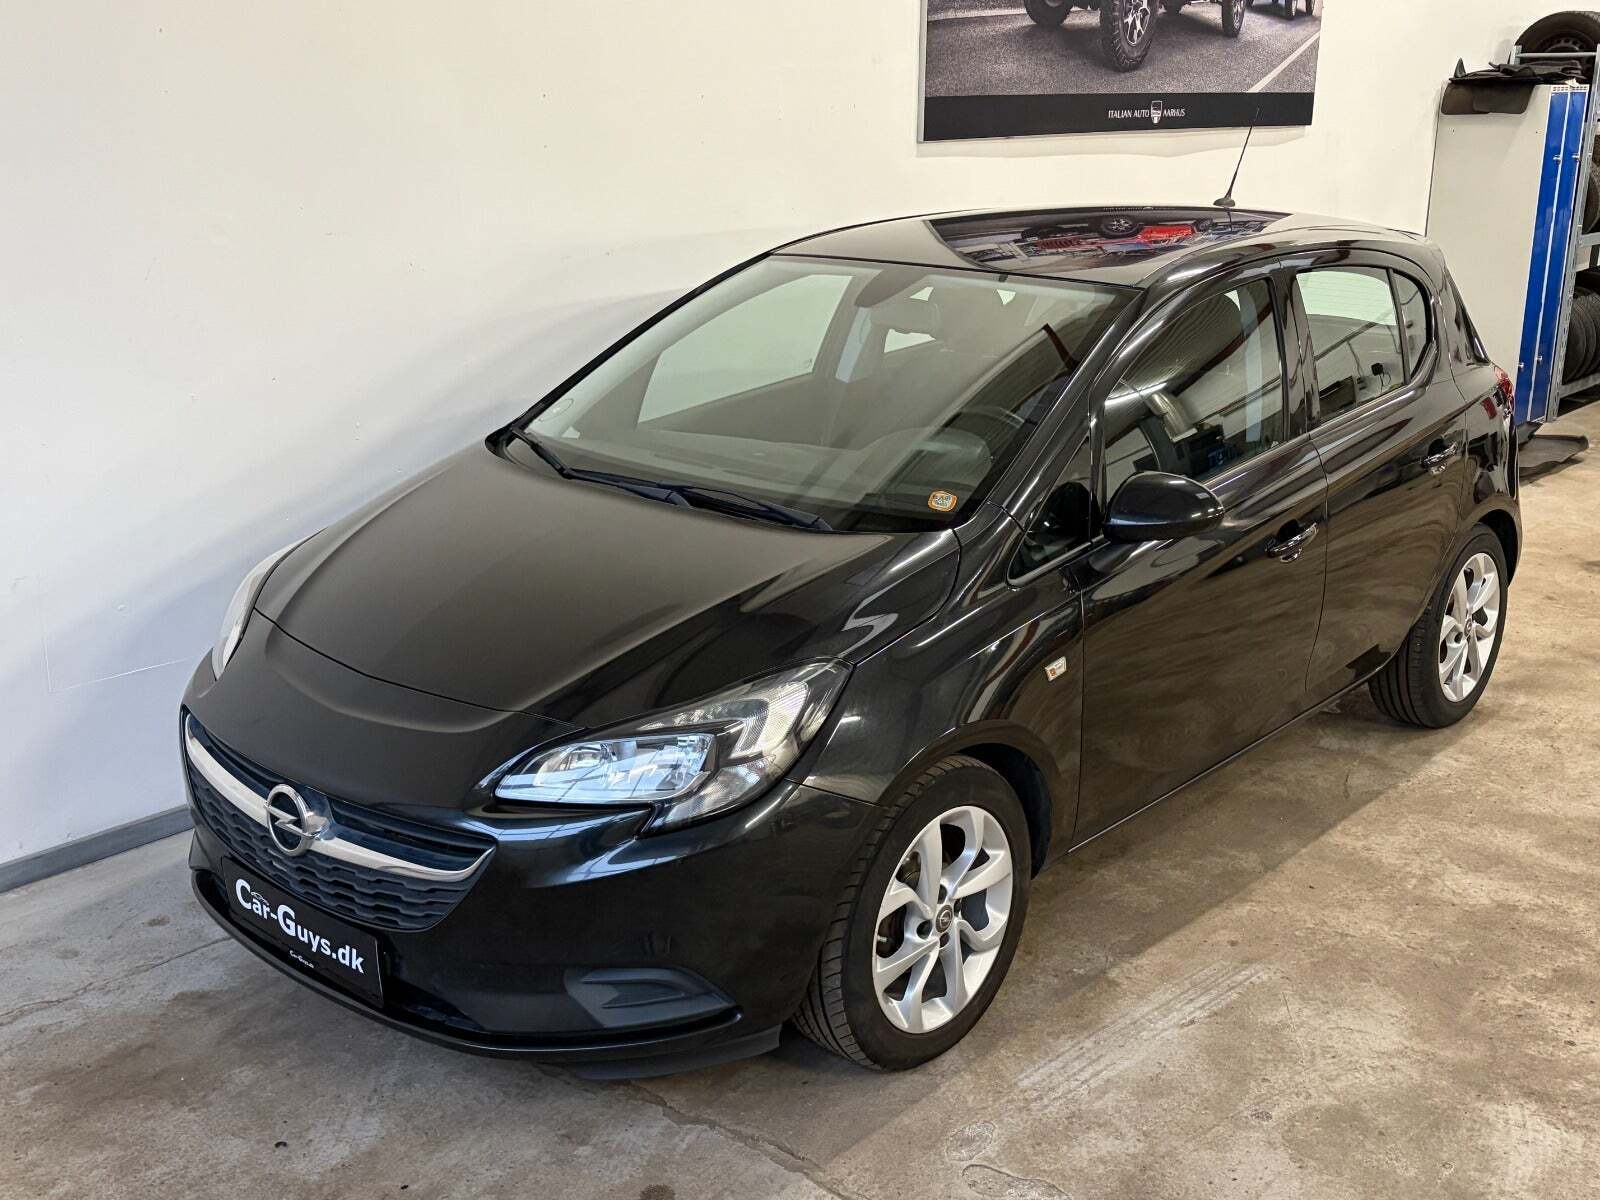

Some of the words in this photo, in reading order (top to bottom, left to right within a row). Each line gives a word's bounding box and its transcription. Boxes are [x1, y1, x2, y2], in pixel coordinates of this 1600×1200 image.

[1108, 109, 1132, 119] ITALIAN
[1133, 109, 1150, 118] AUTO
[1163, 108, 1186, 117] AARHUS
[235, 878, 364, 974] Car-Guys.dk
